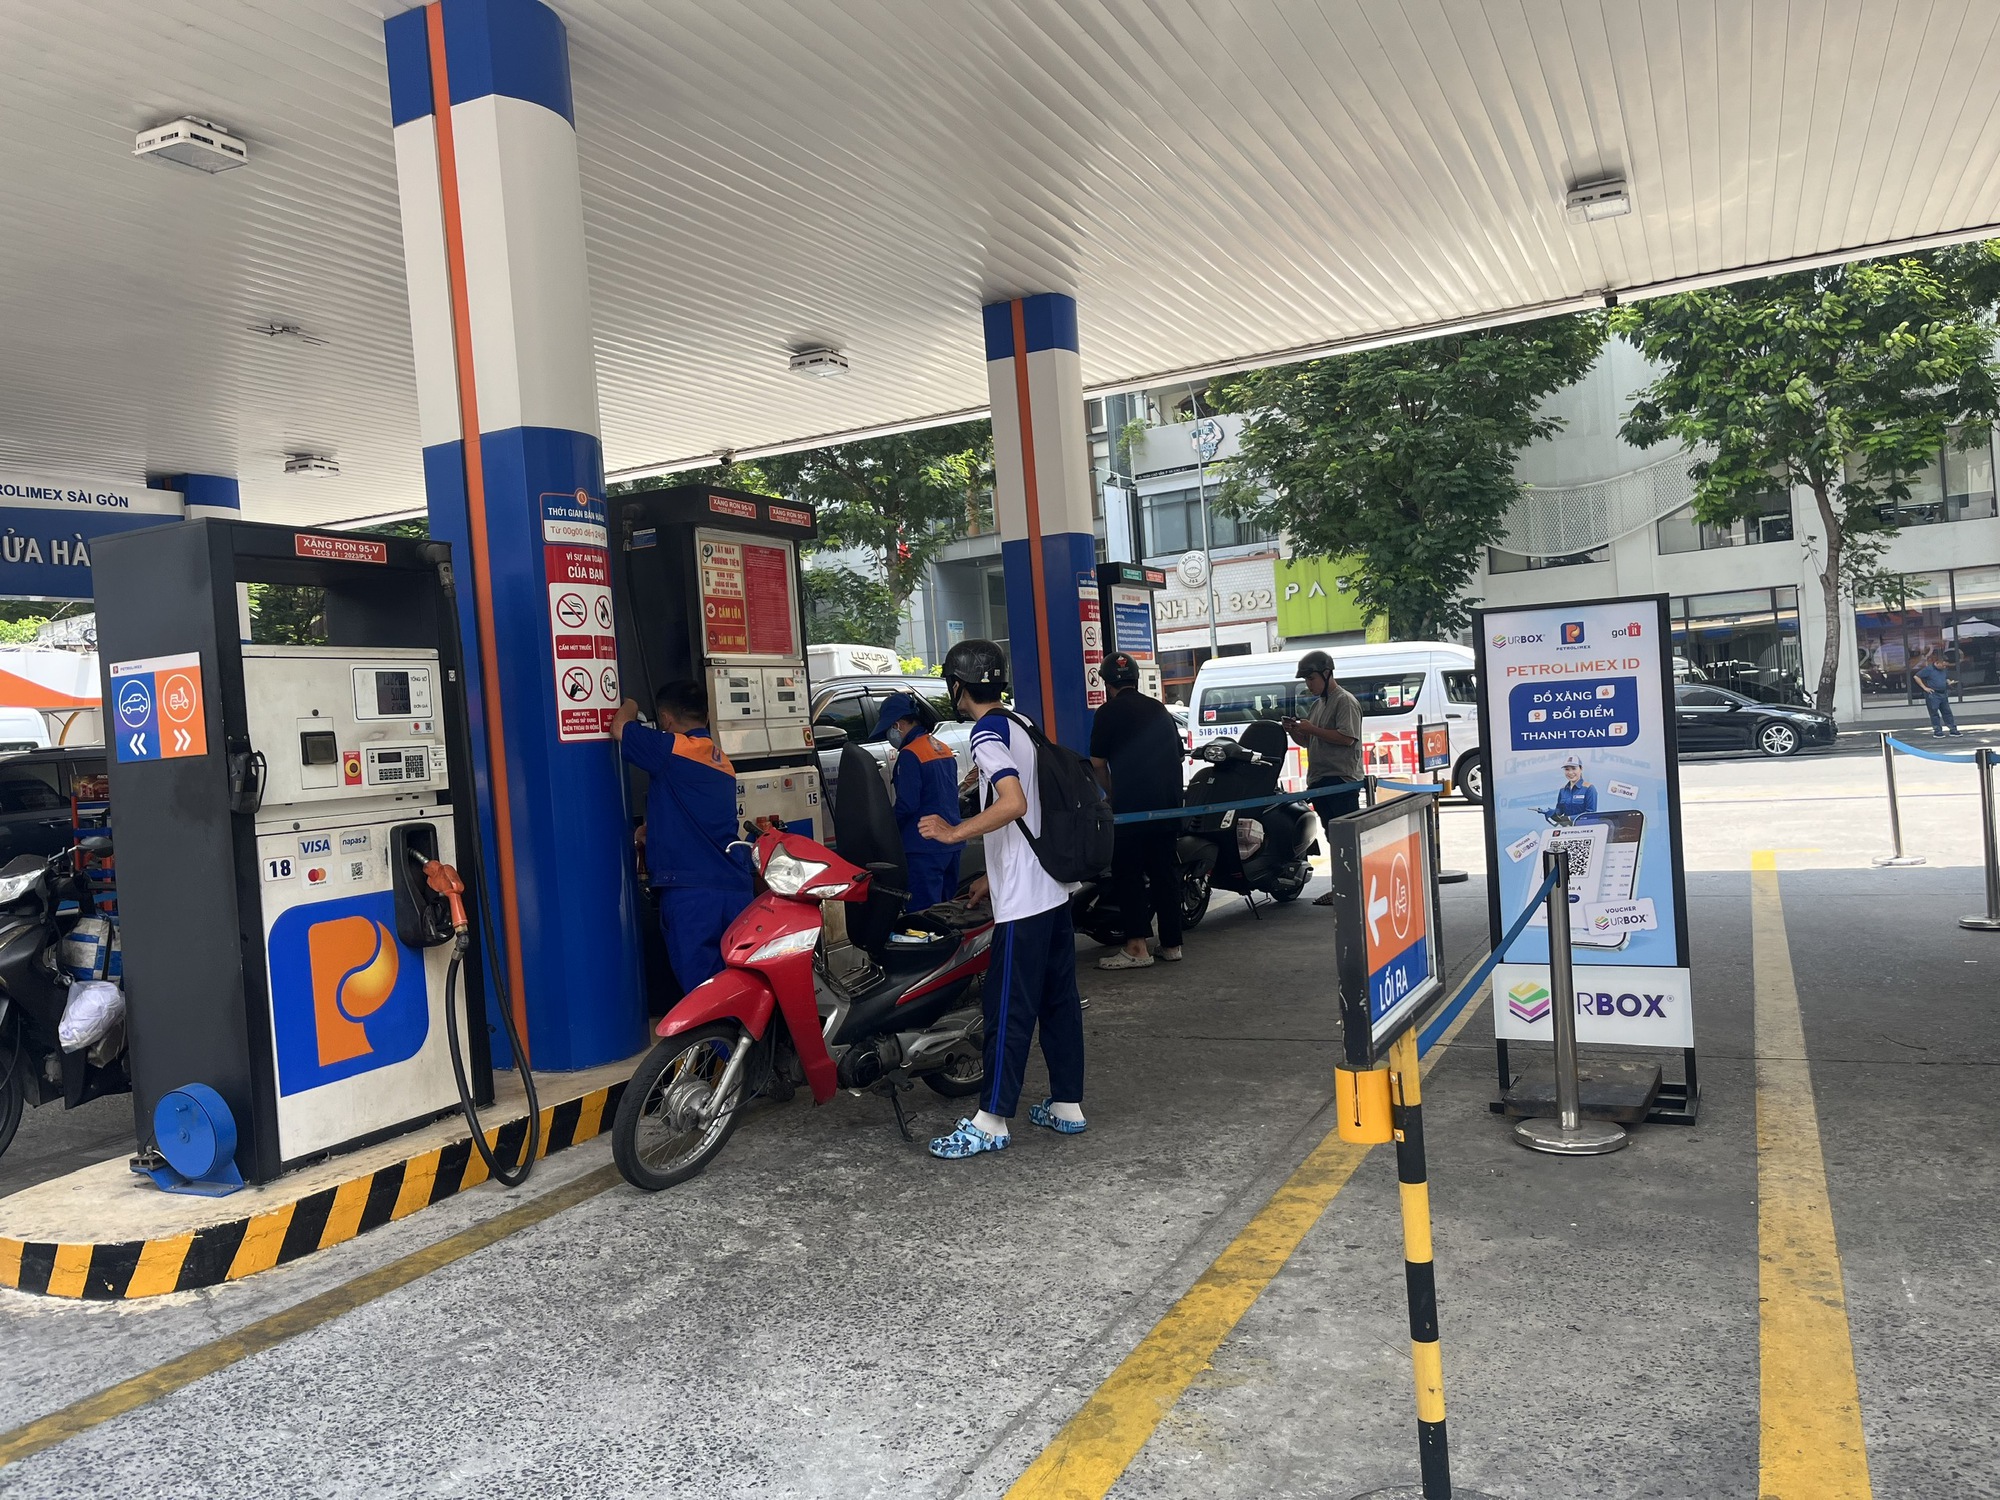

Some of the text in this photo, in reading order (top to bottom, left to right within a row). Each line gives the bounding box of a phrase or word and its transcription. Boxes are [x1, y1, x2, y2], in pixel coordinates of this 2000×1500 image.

[67, 490, 92, 504] SÀI
[96, 493, 129, 508] GÒN
[713, 498, 729, 507] XĂNG
[729, 501, 741, 509] RON
[547, 506, 567, 517] THỜI
[567, 508, 583, 518] GIAN
[550, 525, 561, 534] Từ
[0, 527, 91, 567] ỬA HÀ
[303, 538, 379, 554] XĂNG RON 95-V
[311, 549, 331, 557] TCCS
[331, 550, 339, 558] 01
[344, 551, 373, 561] 2023/PLX
[566, 552, 573, 561] VÌ
[574, 553, 582, 562] SỰ
[567, 563, 604, 582] CỦA BẠN
[1156, 598, 1188, 620] NH
[1230, 589, 1273, 612] 362
[1611, 626, 1638, 638] got it
[850, 651, 889, 663] LUXURY
[1506, 658, 1640, 677] PETROLIMEX ID
[1533, 689, 1592, 703] ĐỔ XĂNG
[1552, 704, 1615, 720] ĐỔI ĐIỂM
[1199, 726, 1239, 737] 51B-149.19
[1521, 727, 1606, 741] THANH TOÁN
[736, 785, 745, 795] SA
[808, 793, 818, 805] 15
[300, 839, 331, 854] VISA
[342, 836, 362, 846] napas
[269, 859, 291, 878] 18
[1605, 905, 1637, 914] VOUCHER
[1610, 914, 1647, 926] URBOX
[1379, 965, 1409, 1012] LỐI RA
